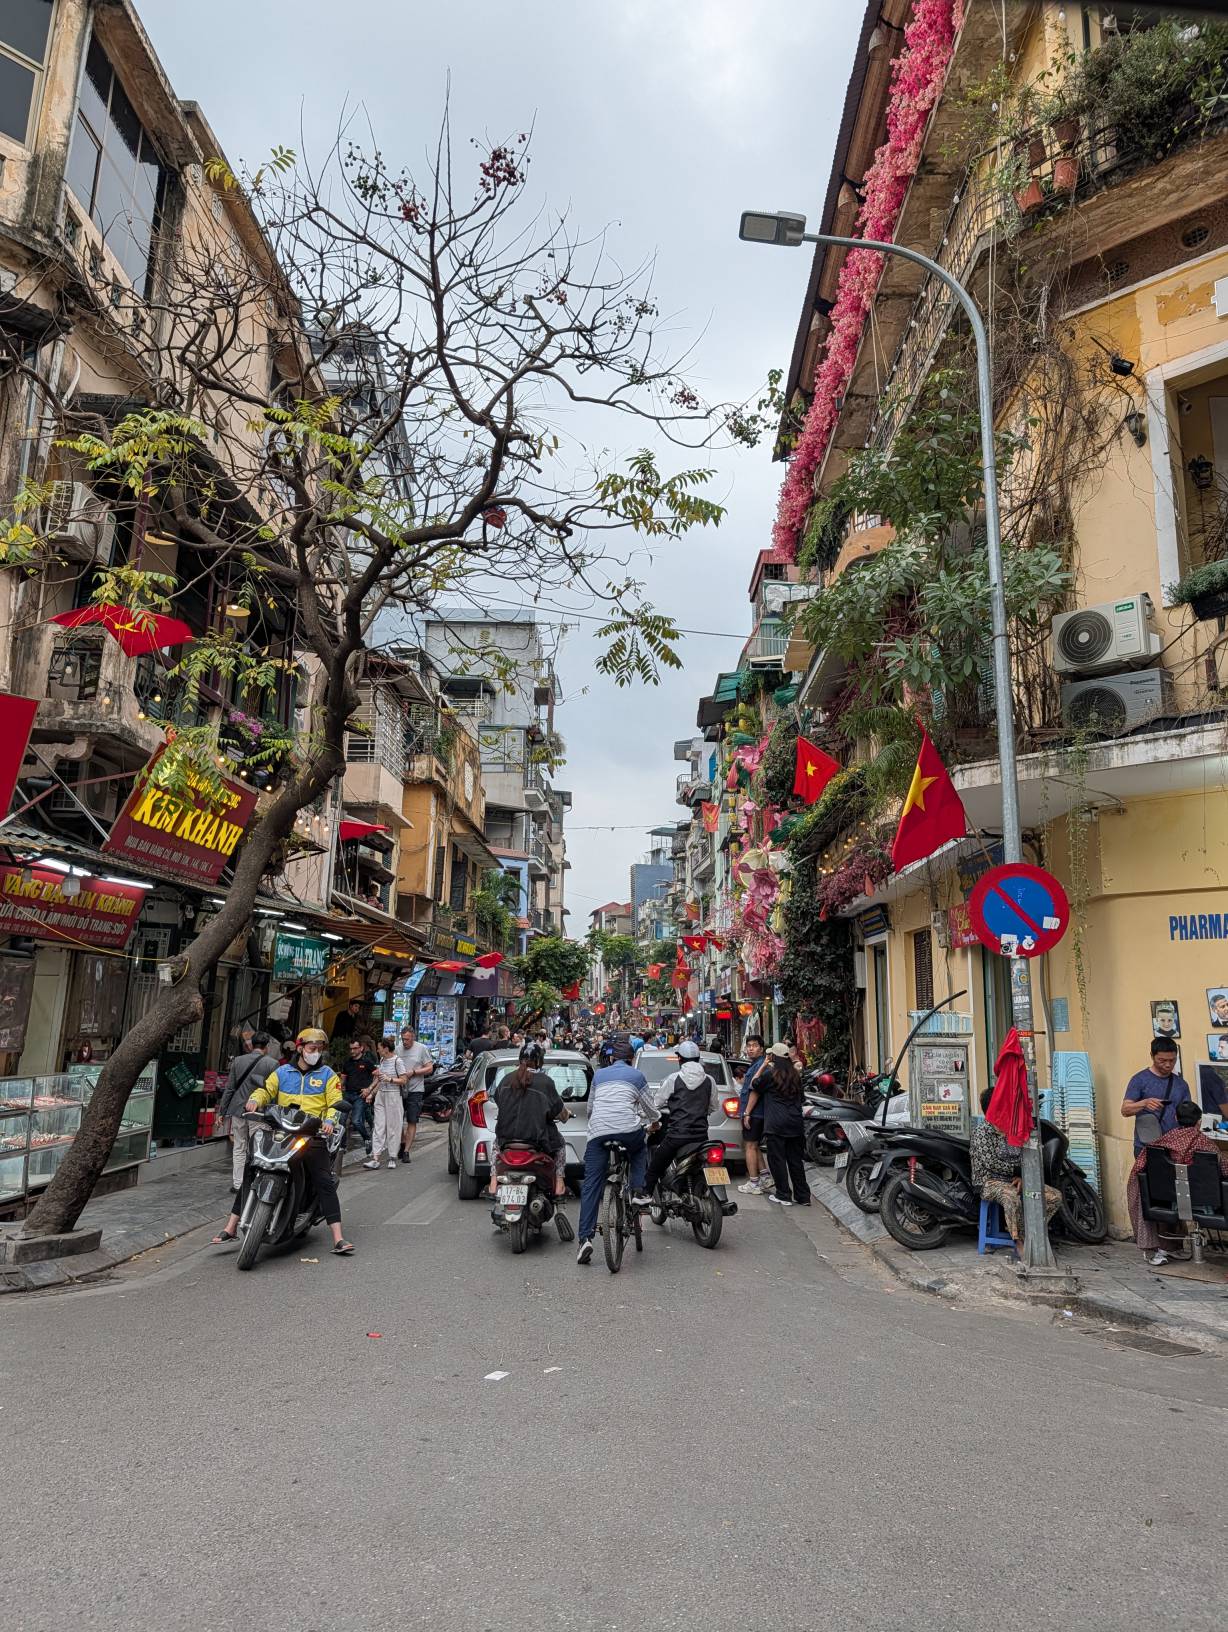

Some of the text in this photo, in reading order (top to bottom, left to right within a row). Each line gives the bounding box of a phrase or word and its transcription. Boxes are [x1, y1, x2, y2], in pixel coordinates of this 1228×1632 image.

[133, 788, 183, 832] KIM
[176, 808, 243, 856] KHÁNH
[96, 892, 136, 916] KHÁNH
[309, 1076, 323, 1088] be
